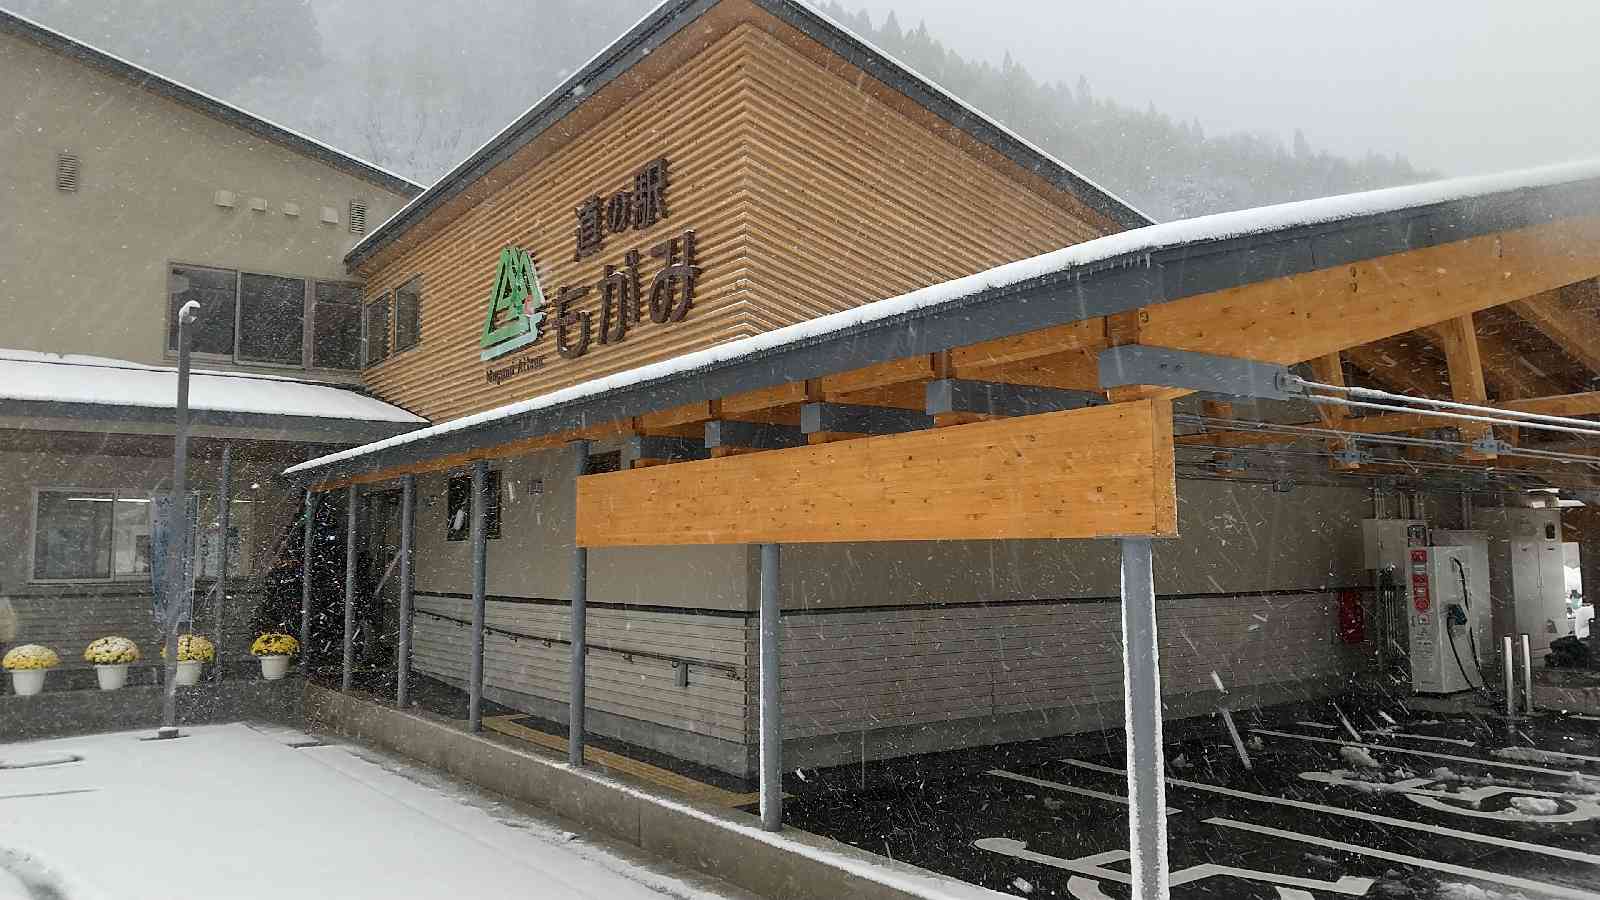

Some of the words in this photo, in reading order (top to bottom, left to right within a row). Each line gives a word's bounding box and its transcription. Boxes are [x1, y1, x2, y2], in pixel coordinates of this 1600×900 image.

[575, 158, 669, 262] 道の駅
[552, 229, 700, 359] もがみ
